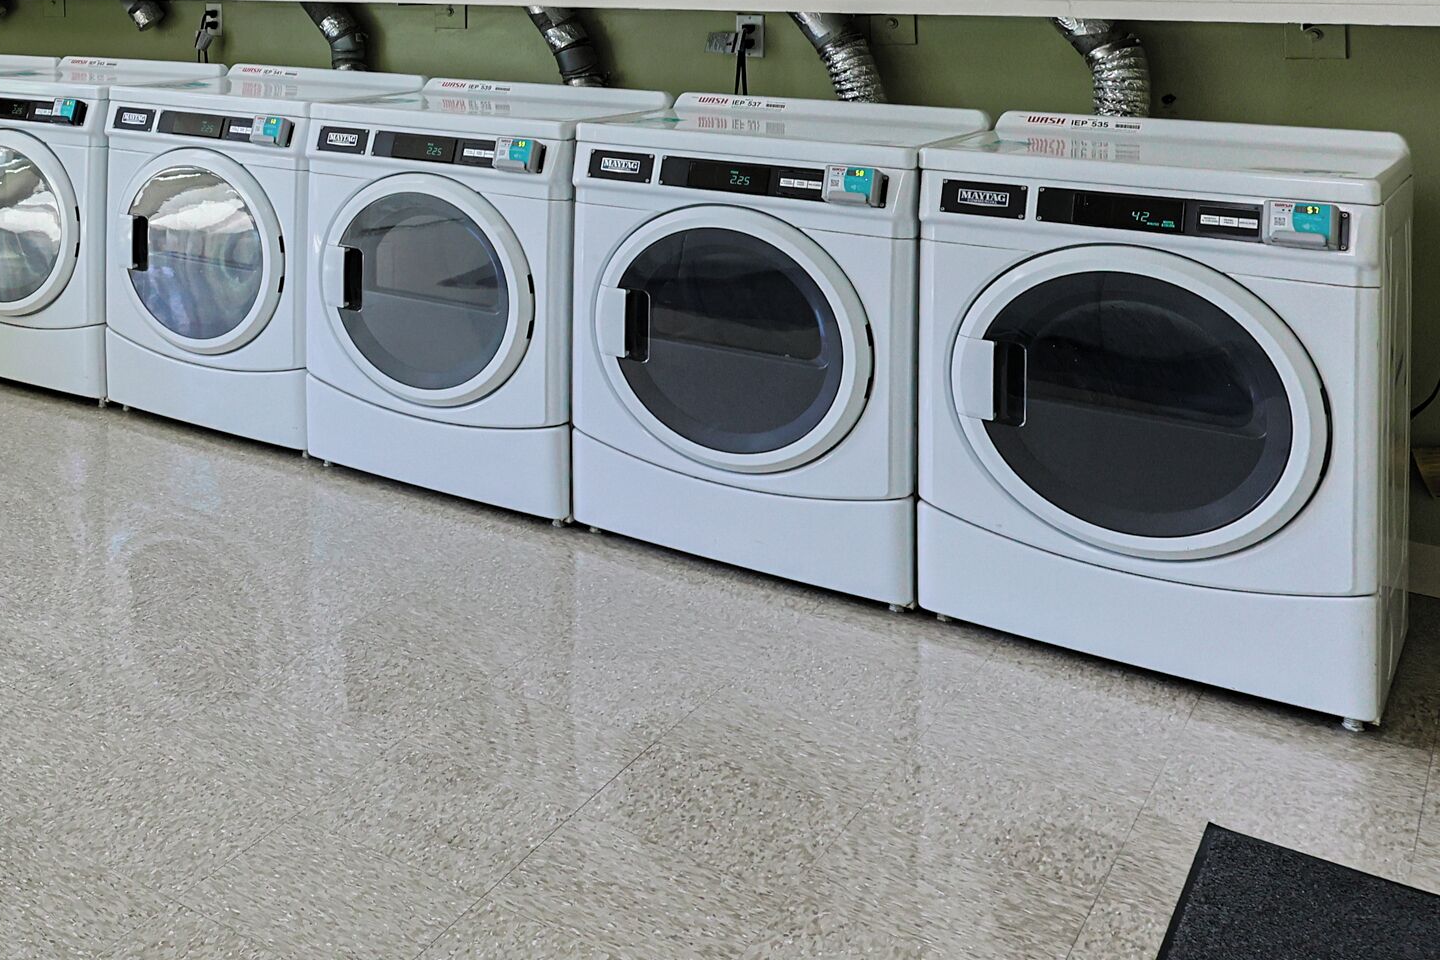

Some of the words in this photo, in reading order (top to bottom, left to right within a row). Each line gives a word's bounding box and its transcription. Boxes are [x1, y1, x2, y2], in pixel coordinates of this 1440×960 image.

[1027, 116, 1066, 124] WASH
[604, 160, 637, 169] MAYTAG
[961, 190, 1006, 202] MAYTAG
[1132, 211, 1150, 222] 42
